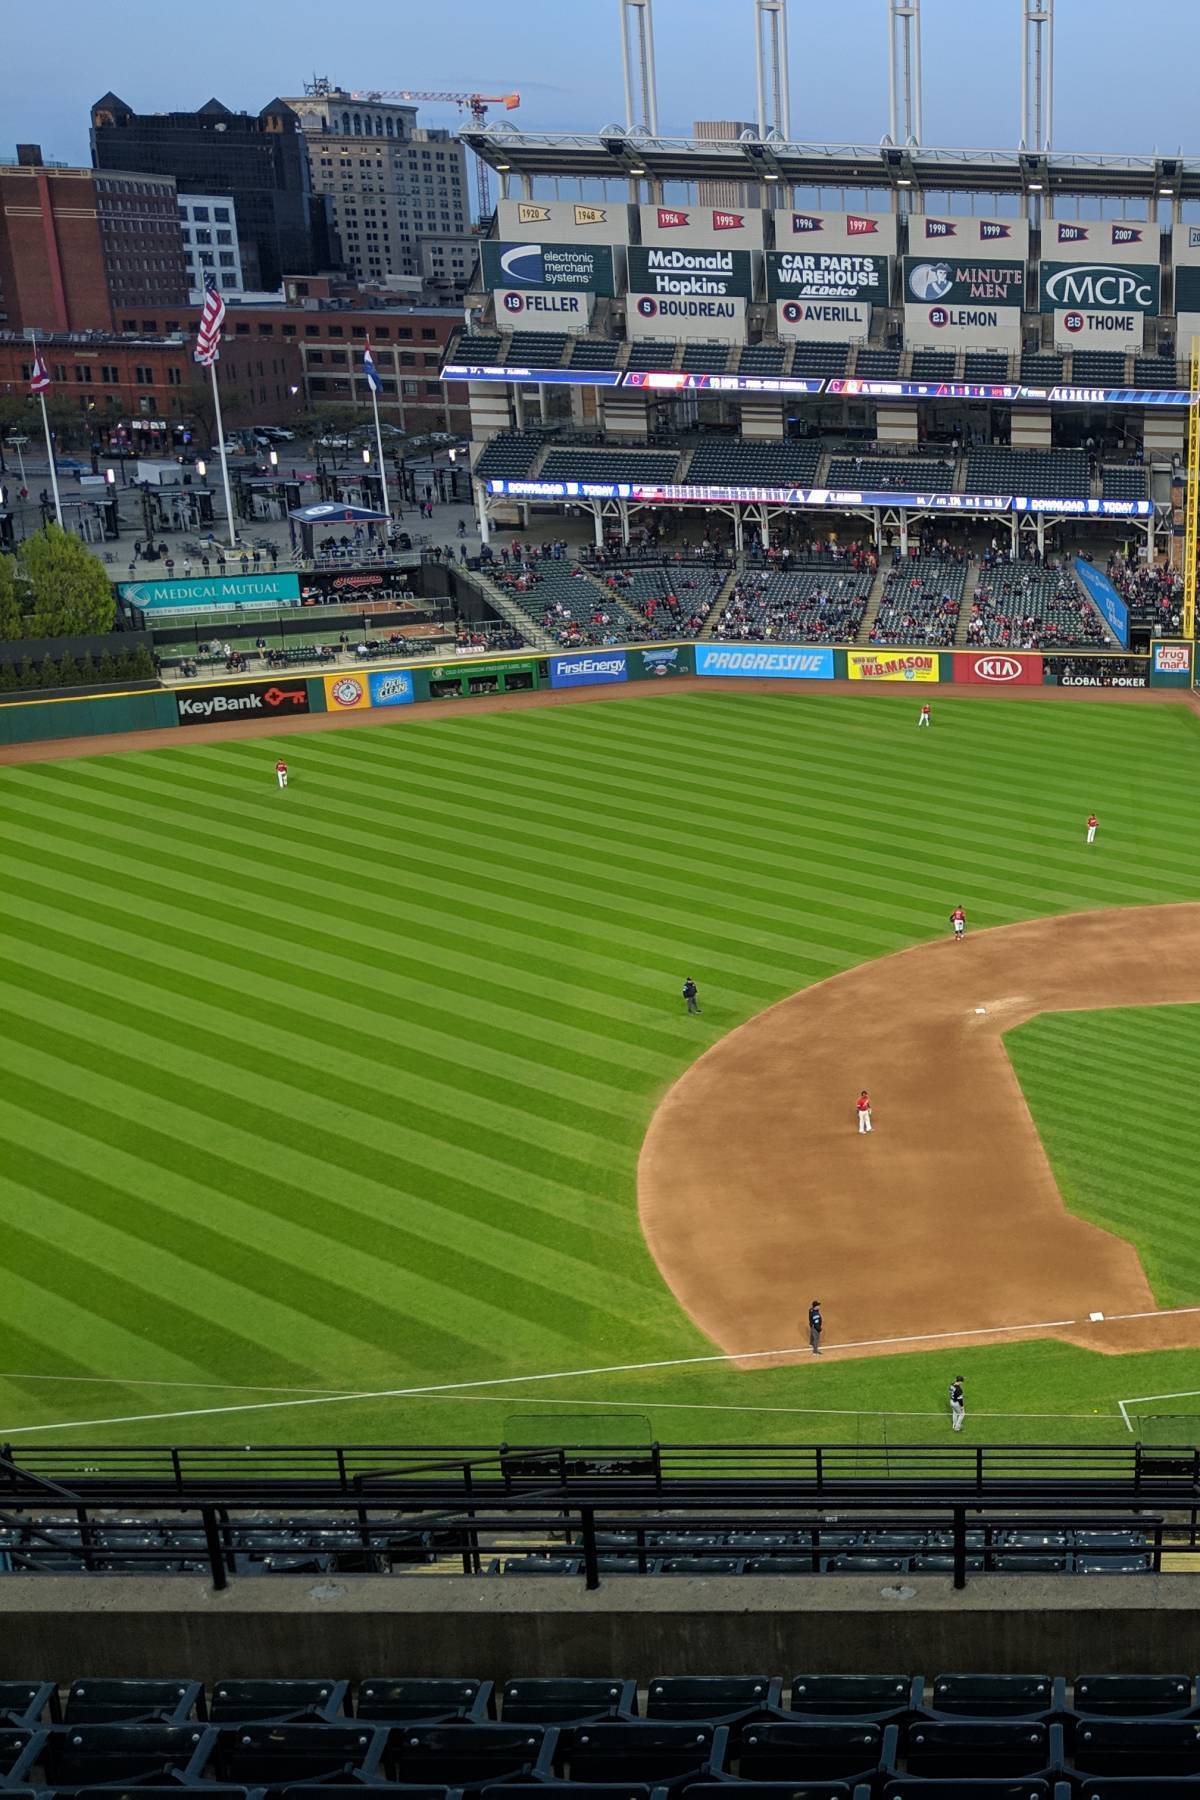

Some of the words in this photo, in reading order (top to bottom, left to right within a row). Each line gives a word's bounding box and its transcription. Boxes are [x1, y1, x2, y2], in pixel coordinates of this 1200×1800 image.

[522, 208, 540, 220] 1920
[578, 210, 596, 221] 1948
[660, 213, 679, 224] 1954
[716, 215, 734, 226] 1995
[795, 218, 814, 229] 1996
[850, 220, 867, 231] 1997
[928, 223, 946, 234] 1998
[983, 225, 1000, 236] 1999
[1060, 228, 1078, 239] 2001
[1114, 230, 1132, 240] 2007
[544, 251, 594, 264] electronic
[648, 251, 733, 270] McDonald
[781, 254, 816, 270] CAR
[820, 257, 874, 272] PARTS
[544, 262, 594, 274] merchant
[544, 272, 592, 284] systems
[778, 268, 879, 286] WAREHOUSE
[955, 268, 1022, 284] MINUTE
[656, 276, 727, 296] Hopkins
[800, 284, 858, 297] ACDelco
[969, 282, 1008, 298] MEN
[506, 296, 520, 309] 19
[526, 296, 578, 312] FELLER
[642, 300, 652, 312] 5
[659, 300, 735, 317] BOUDREAU
[788, 306, 797, 318] 3
[804, 306, 862, 322] AVERILL
[932, 312, 944, 323] 21
[950, 311, 997, 326] LEMON
[1067, 316, 1081, 328] 25
[1086, 316, 1134, 331] THOME
[1032, 500, 1085, 512] DOWNLOAD
[1103, 502, 1133, 513] TODAY
[154, 586, 218, 600] MEDICAL
[222, 582, 279, 596] MUTUAL
[1158, 646, 1184, 662] drug
[556, 660, 626, 675] FirstEnergy
[704, 652, 826, 673] PROGRESSIVE
[982, 661, 1014, 675] KIA
[1160, 660, 1188, 669] mart
[1062, 676, 1102, 686] GLOBAL
[1112, 678, 1145, 687] POKER
[380, 684, 406, 698] CLEAN
[179, 692, 262, 716] KeyBank
